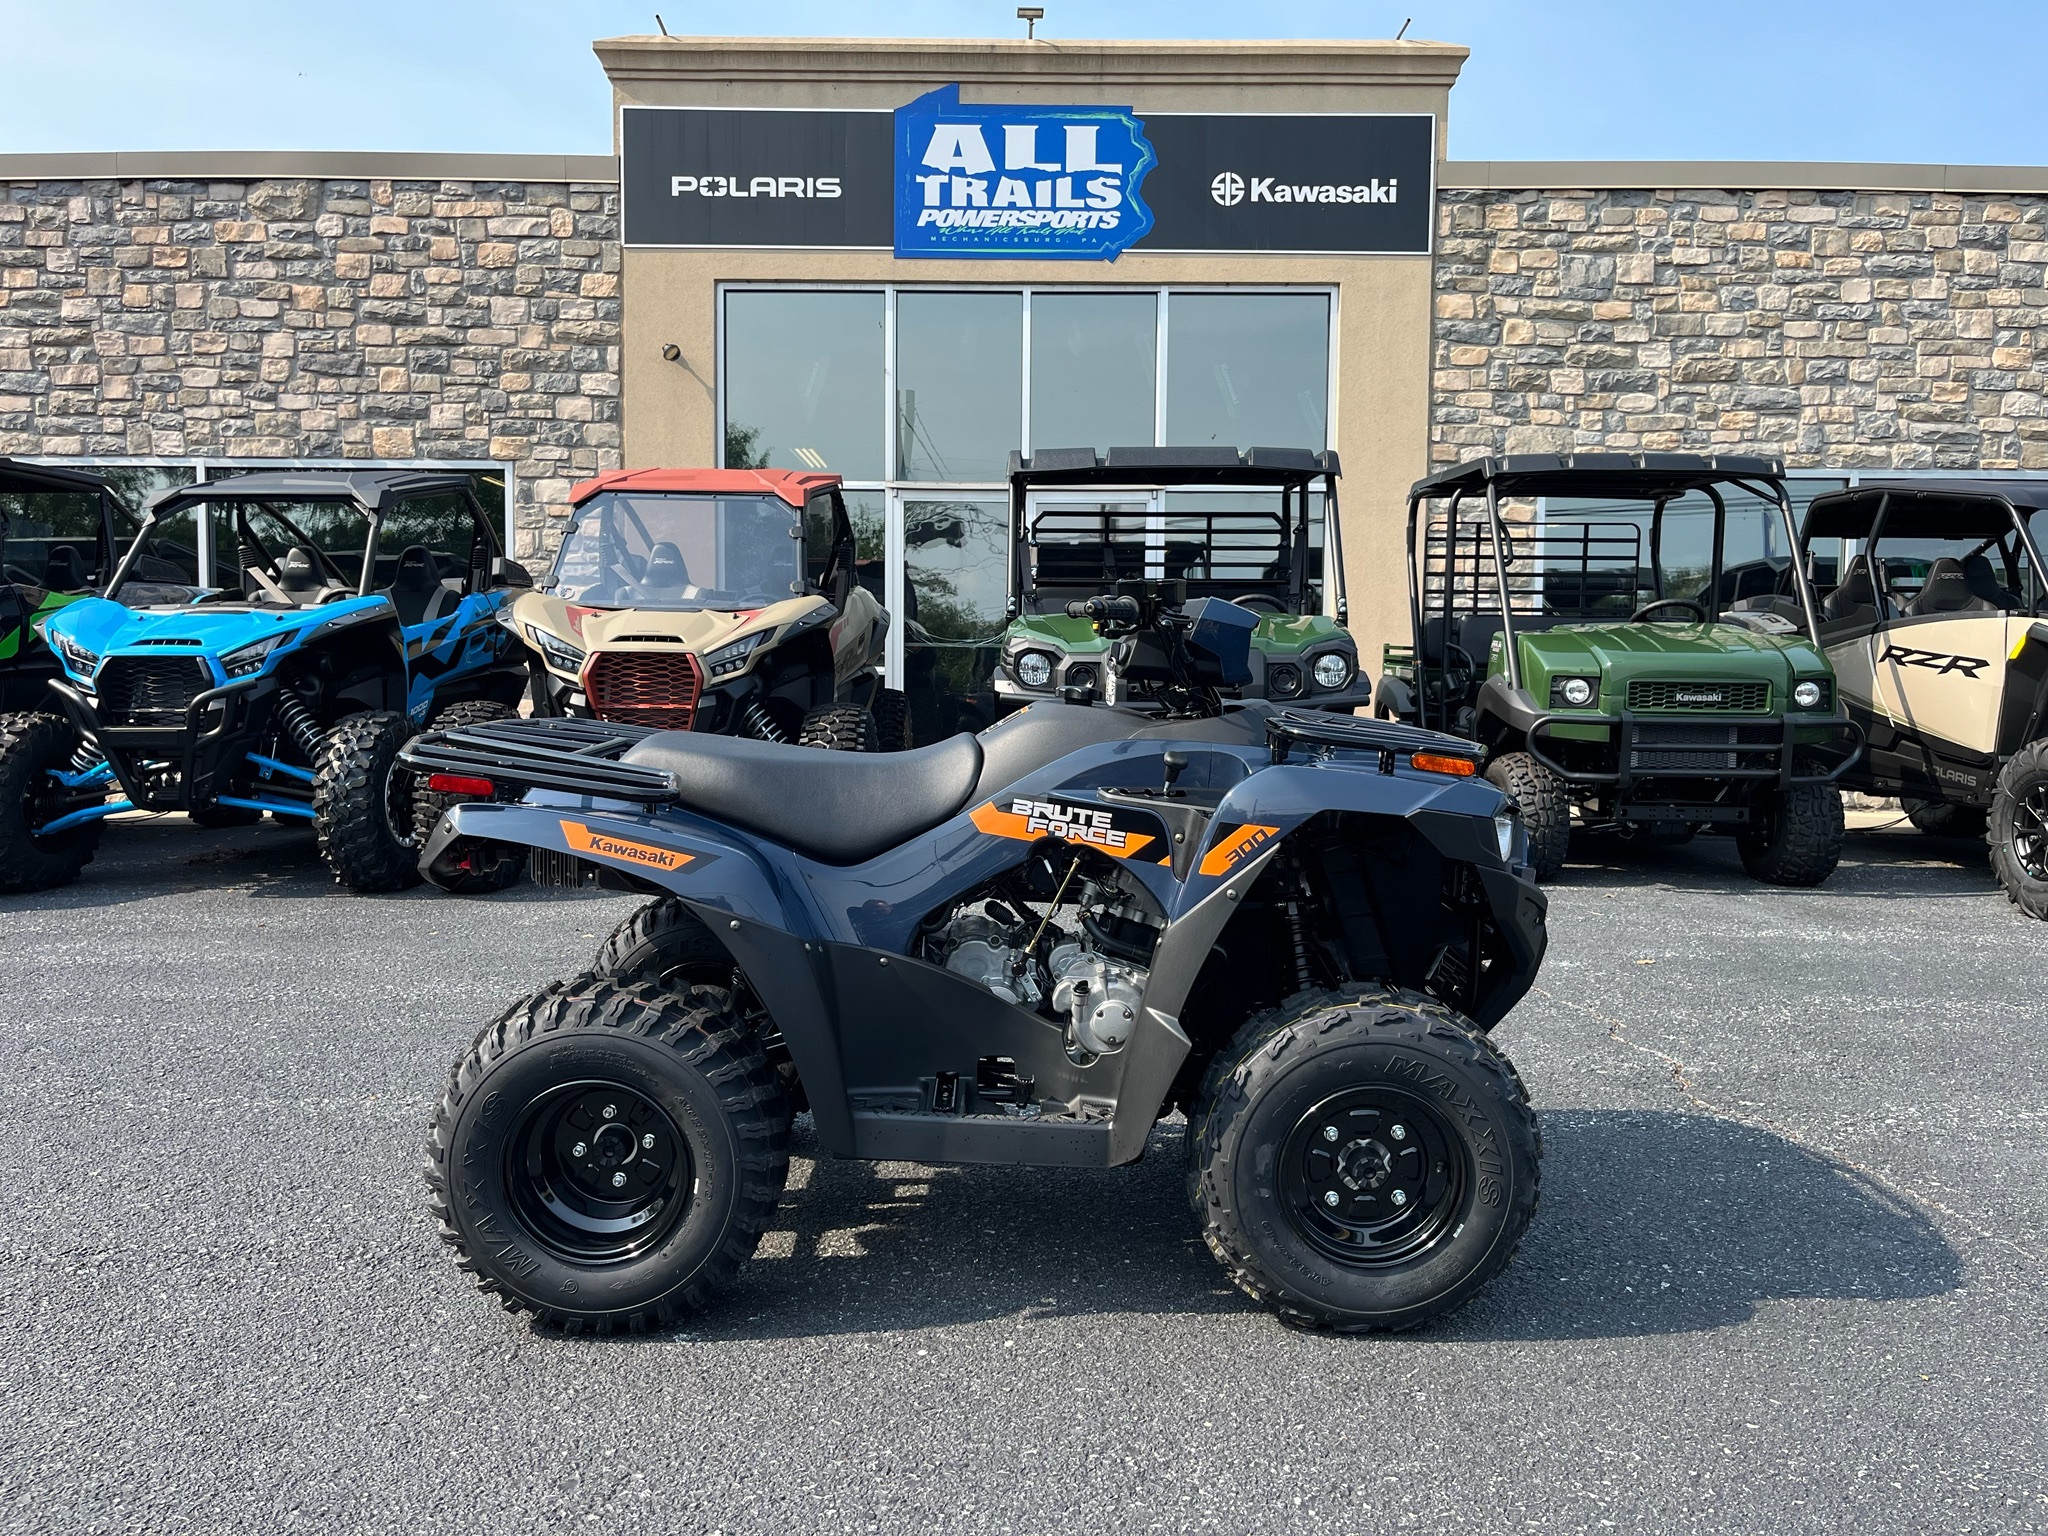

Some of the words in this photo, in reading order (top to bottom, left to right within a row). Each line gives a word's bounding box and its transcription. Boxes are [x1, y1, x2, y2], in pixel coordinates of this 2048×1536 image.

[921, 123, 1123, 176] ALL
[671, 175, 842, 198] POLARIS
[915, 174, 1122, 209] TRAILS
[1250, 177, 1398, 204] Kawasaki
[916, 208, 1122, 229] POWERSPORTS
[1878, 644, 1991, 680] RZR
[1675, 693, 1722, 702] Kawasaki
[1011, 797, 1114, 829] BRUTE
[1025, 816, 1129, 848] FORCE
[1223, 828, 1272, 863] 300
[589, 836, 676, 867] Kawasaki
[1382, 1054, 1503, 1209] MAXXIS
[461, 1089, 542, 1281] MAXXIS
